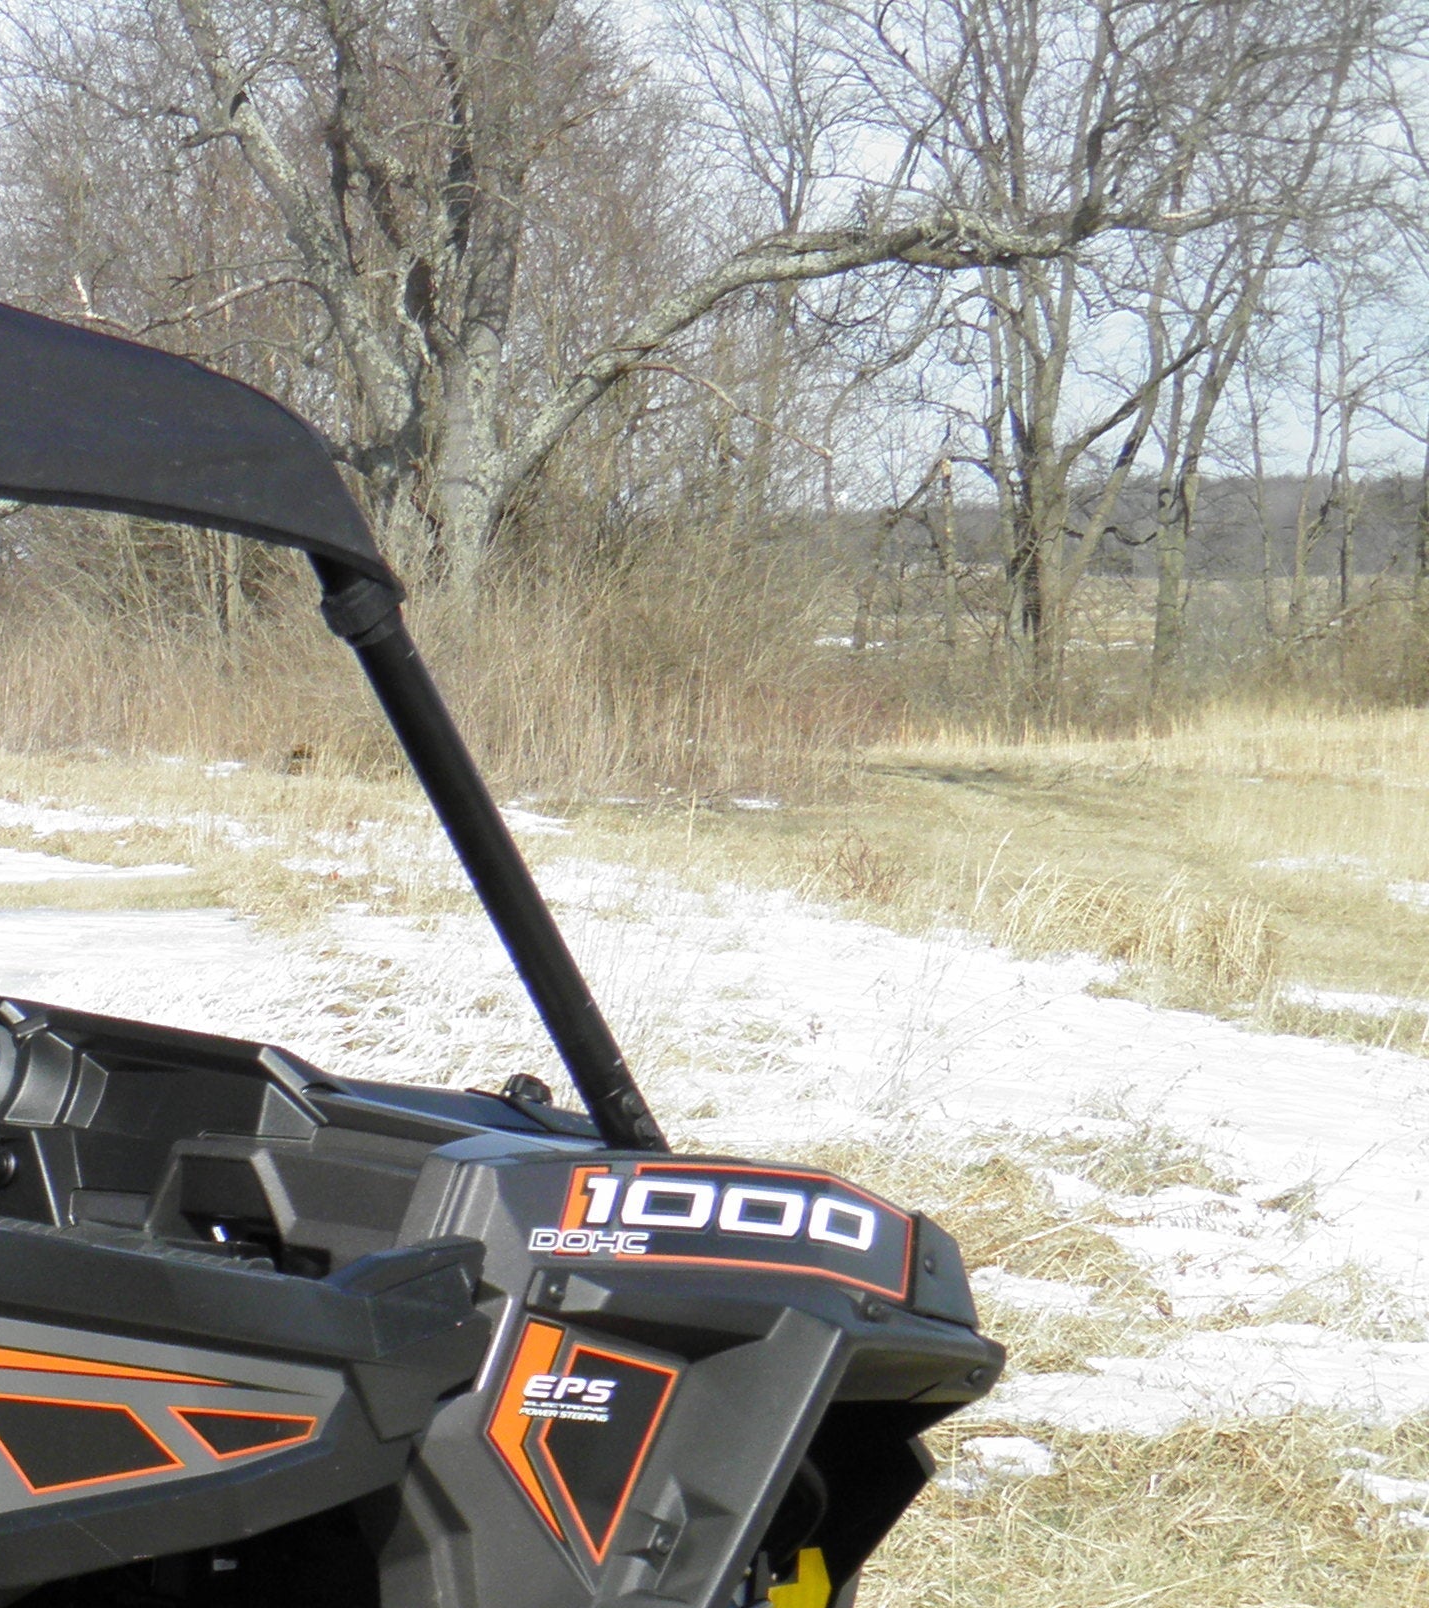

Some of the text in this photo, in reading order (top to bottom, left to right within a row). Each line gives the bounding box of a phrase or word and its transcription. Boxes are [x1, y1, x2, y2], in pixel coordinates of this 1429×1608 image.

[585, 1175, 877, 1251] 1000
[528, 1228, 649, 1254] DOHC
[523, 1374, 617, 1404] EPS
[518, 1407, 610, 1423] POWER STEERING
